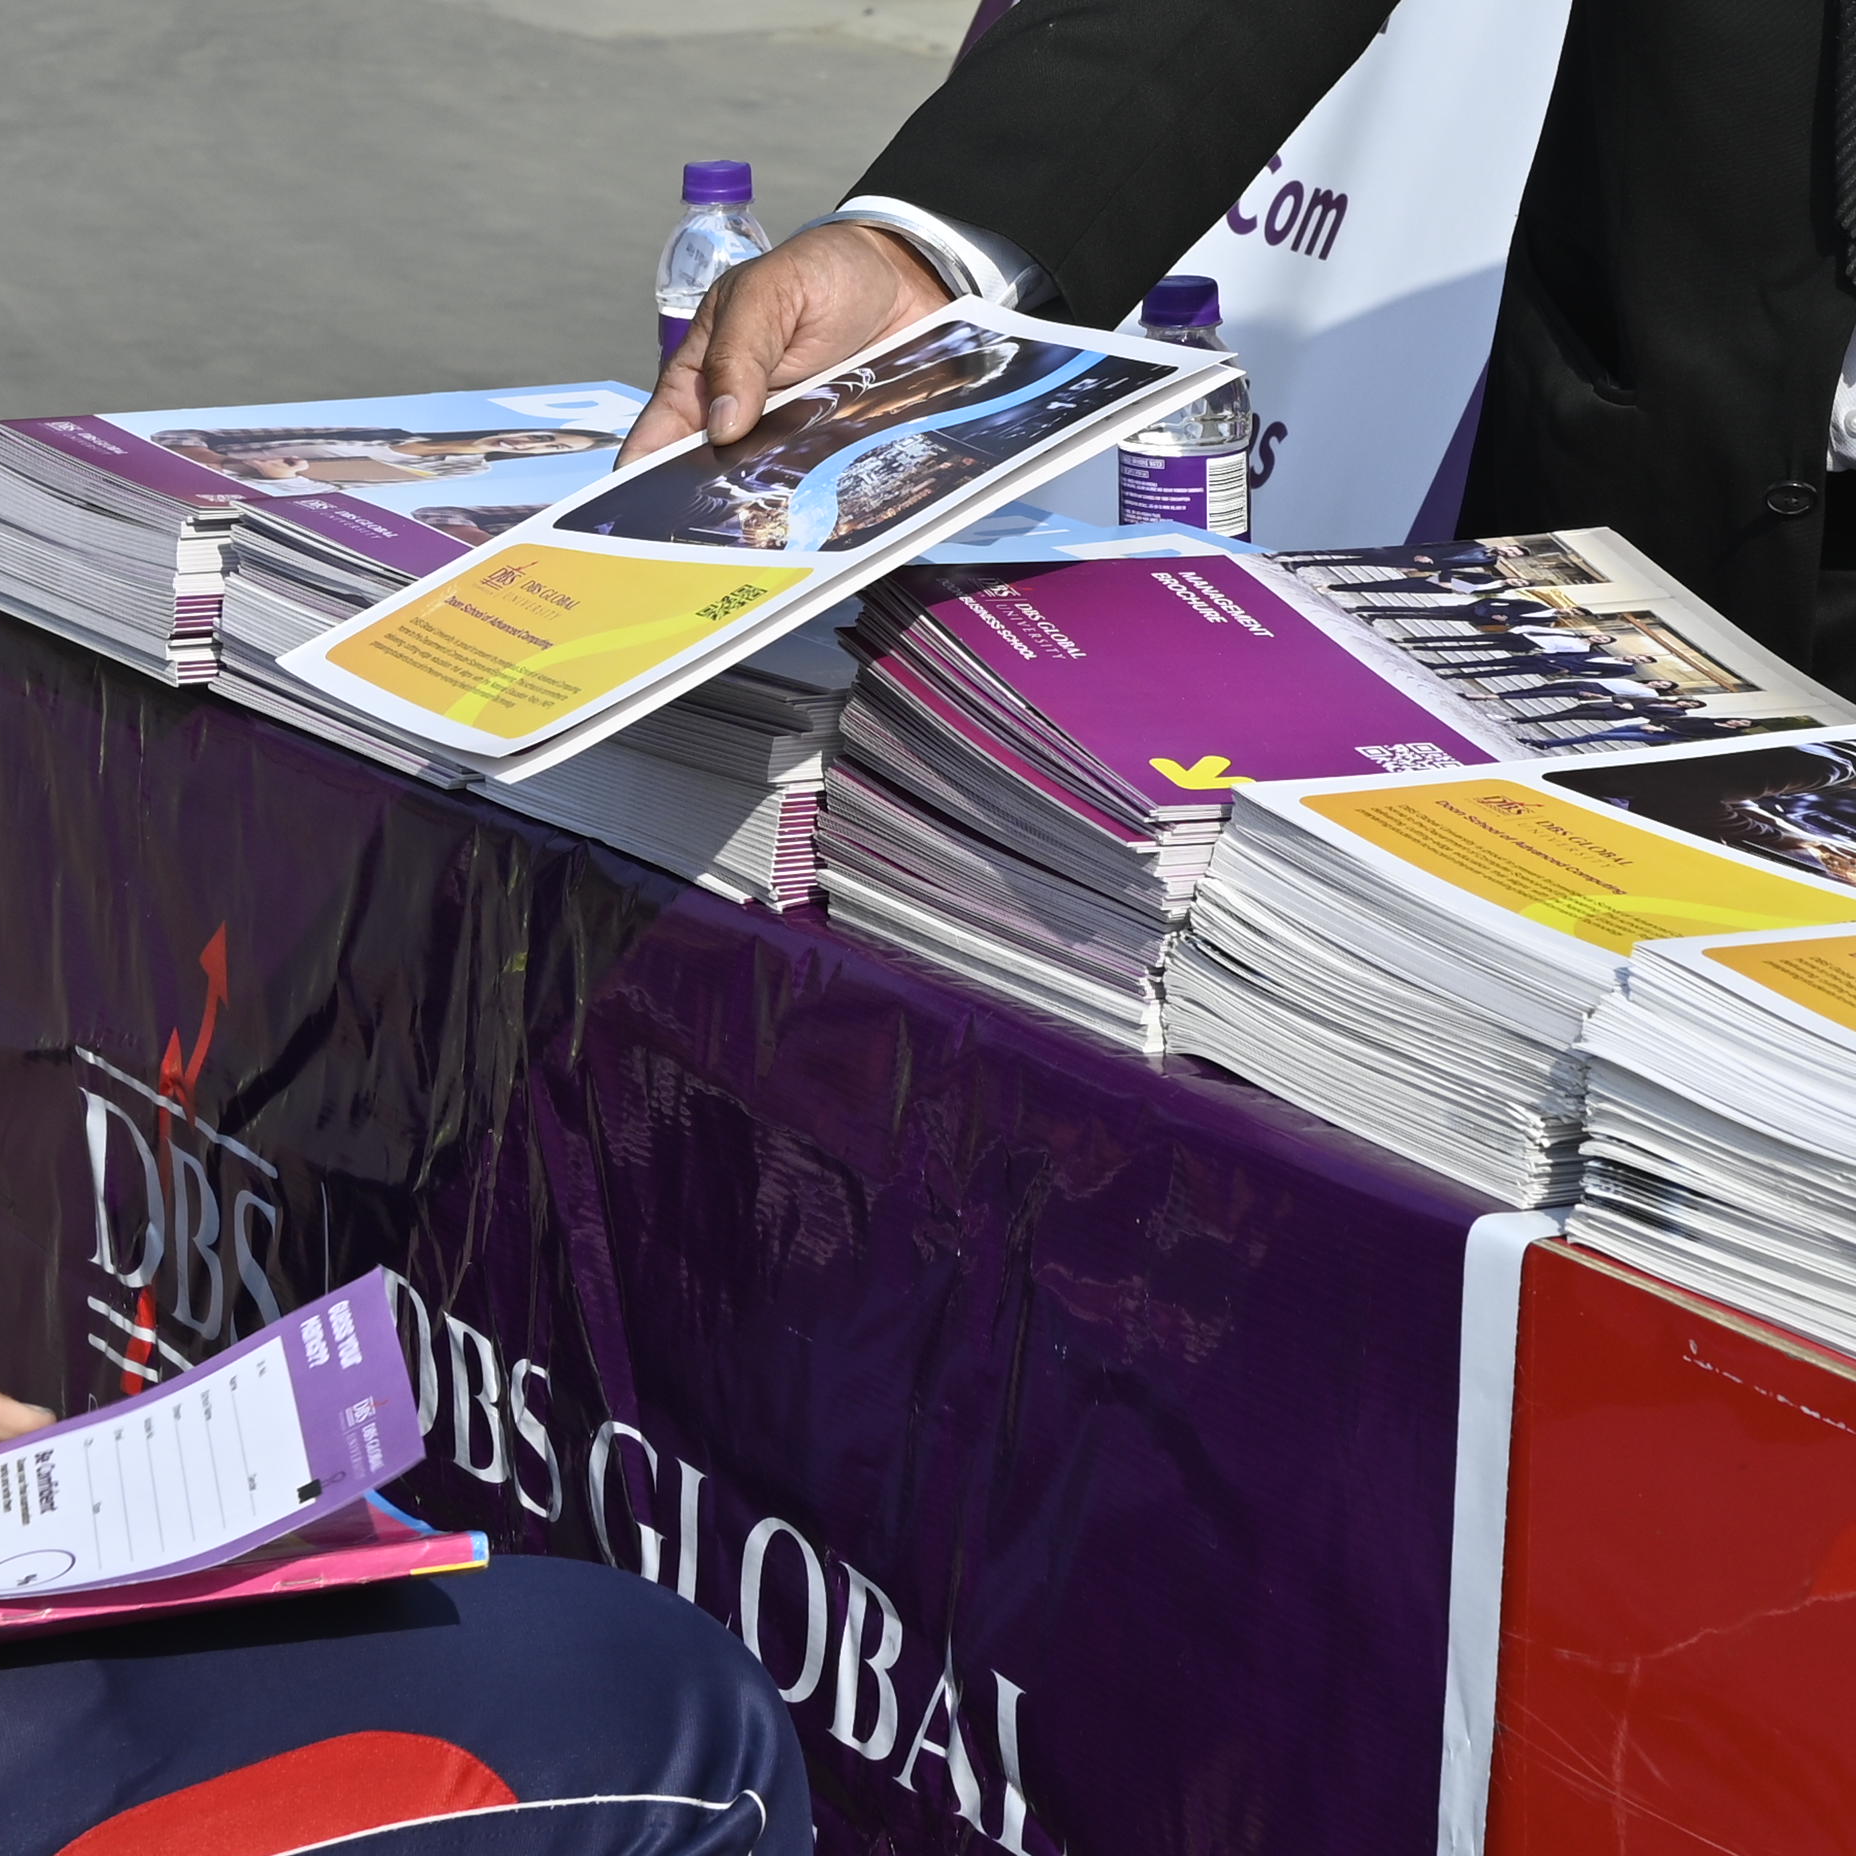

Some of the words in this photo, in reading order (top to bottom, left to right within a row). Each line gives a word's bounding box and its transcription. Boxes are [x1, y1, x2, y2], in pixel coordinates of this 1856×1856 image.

[538, 587, 582, 612] GLOBAL
[1151, 571, 1228, 624] BROCHURE
[1178, 571, 1276, 639] MANAGEMENT
[460, 601, 488, 619] School
[487, 615, 527, 638] Advanced
[516, 629, 556, 653] Computing
[958, 596, 1006, 630] BUSINESS
[997, 629, 1038, 660] SCHOOL
[995, 604, 1066, 660] UNIVERSITY
[1014, 603, 1045, 621] DBS
[1037, 621, 1088, 660] GLOBAL
[1479, 792, 1529, 818] DBS
[1434, 798, 1468, 817] Doon
[1463, 814, 1505, 836] School
[1511, 841, 1570, 870] Advanced
[1562, 865, 1628, 898] Computing
[1536, 819, 1576, 839] DBS
[1565, 834, 1636, 867] GLOBAL
[78, 1086, 283, 1340] DBS
[328, 1300, 355, 1343] GUESS
[337, 1333, 363, 1370] YOUR
[353, 1398, 370, 1424] DBS
[33, 1448, 54, 1464] Be
[36, 1463, 58, 1515] Confident
[382, 1267, 564, 1523] DBS
[588, 1420, 1038, 1856] GLOBAL
